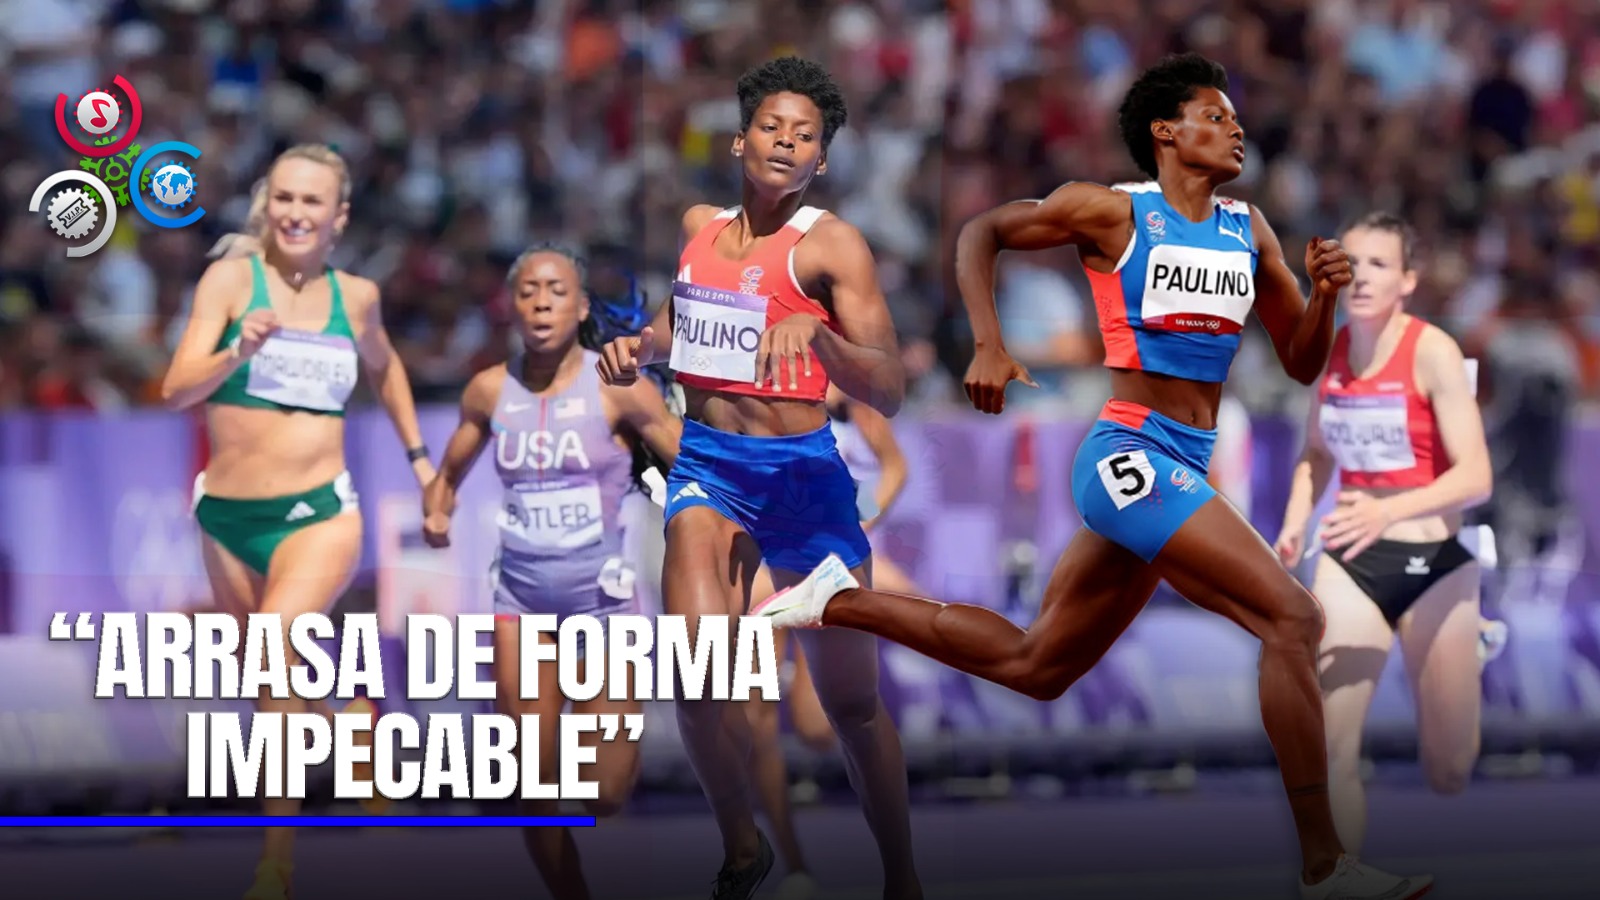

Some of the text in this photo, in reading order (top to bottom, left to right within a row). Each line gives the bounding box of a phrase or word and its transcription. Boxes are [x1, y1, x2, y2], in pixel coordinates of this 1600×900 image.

[686, 287, 711, 299] PARIS
[1152, 264, 1249, 297] PAULINO
[674, 312, 761, 352] PAULINO
[497, 429, 590, 470] USA
[1109, 454, 1146, 497] 5
[506, 502, 591, 530] BUTLER
